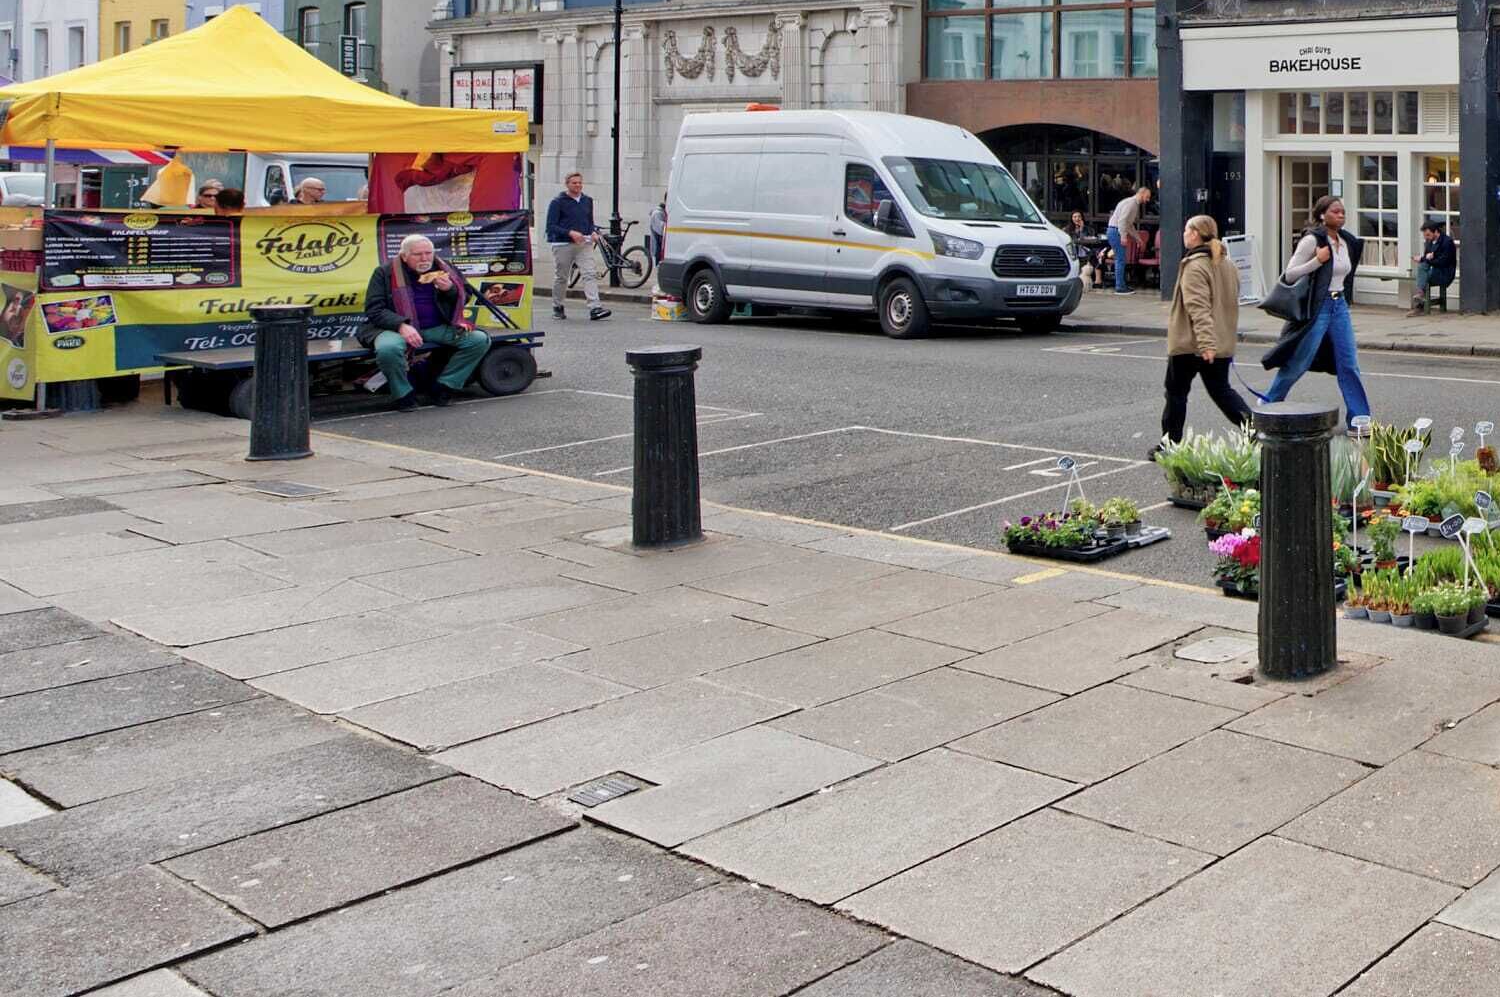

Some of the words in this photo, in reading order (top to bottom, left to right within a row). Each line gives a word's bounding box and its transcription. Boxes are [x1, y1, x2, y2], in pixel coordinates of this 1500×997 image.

[344, 39, 355, 74] HONEST
[1269, 57, 1361, 73] BAKEHOUSE
[1225, 171, 1241, 181] 193
[256, 231, 363, 256] Falafel
[295, 250, 323, 260] Zaki
[303, 292, 359, 309] Zaki
[184, 336, 225, 350] Tel:
